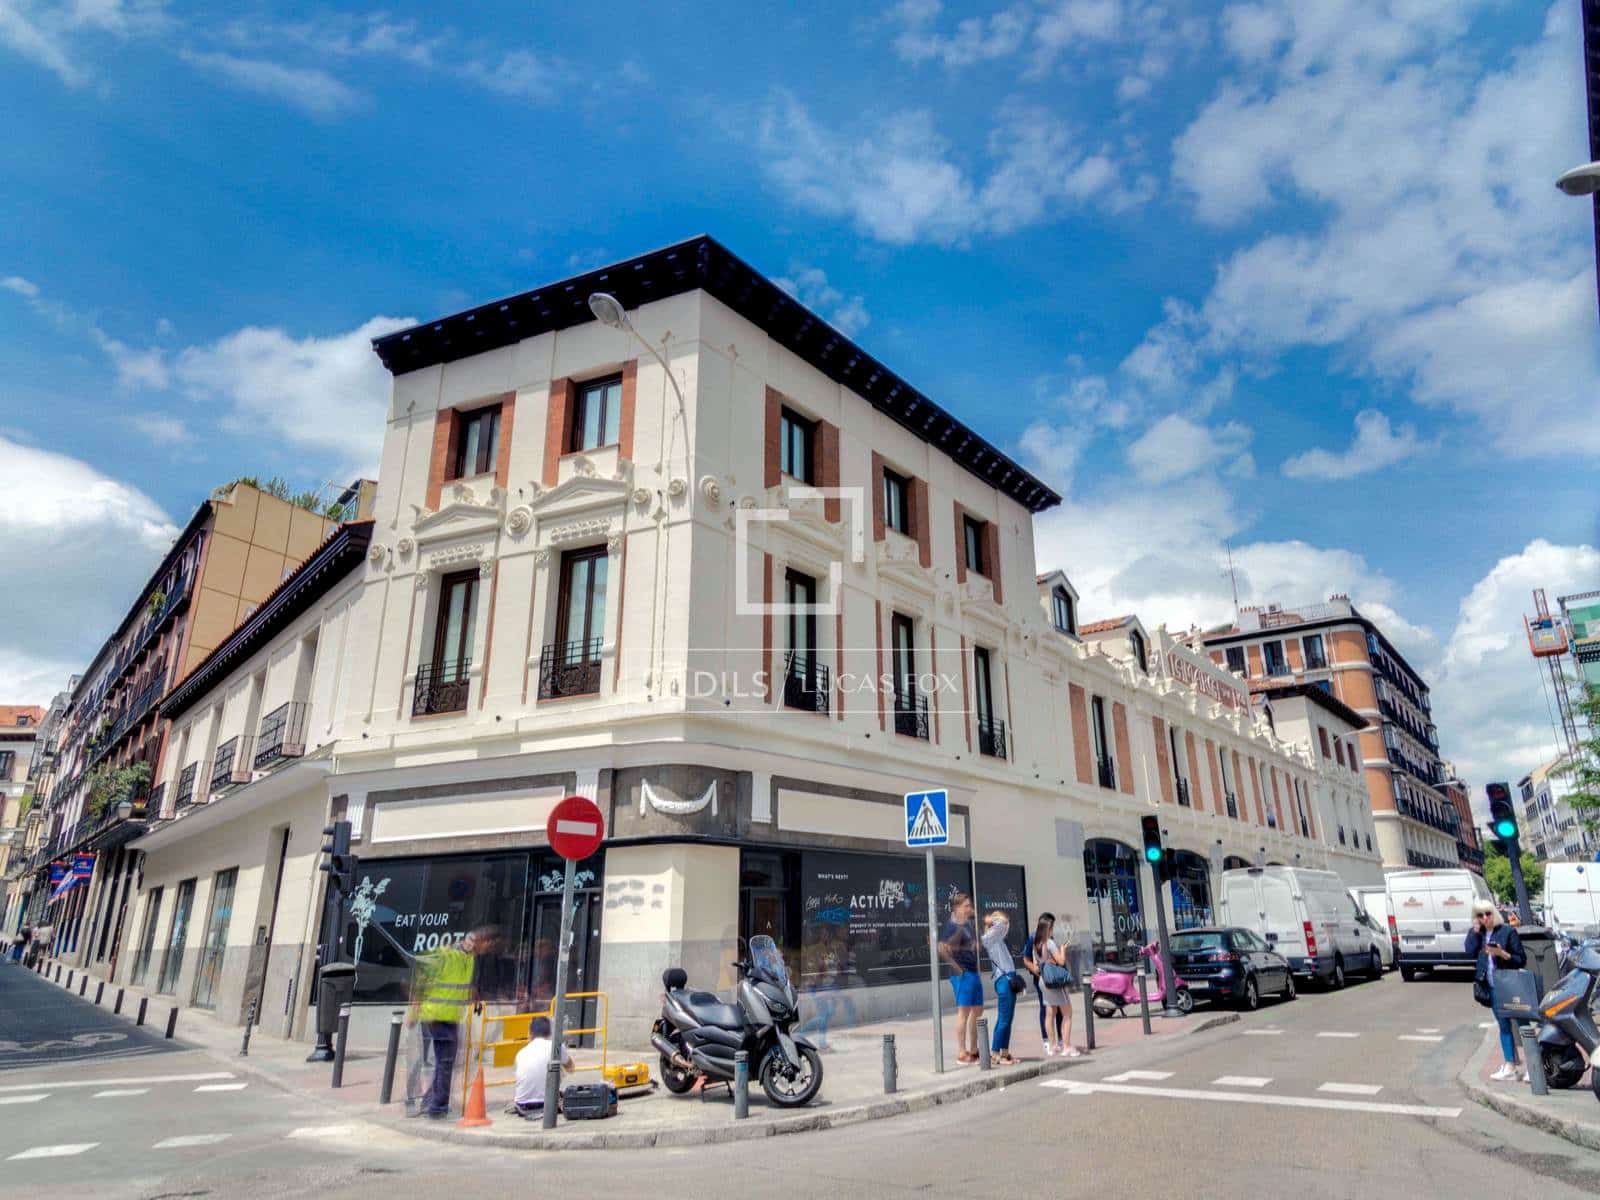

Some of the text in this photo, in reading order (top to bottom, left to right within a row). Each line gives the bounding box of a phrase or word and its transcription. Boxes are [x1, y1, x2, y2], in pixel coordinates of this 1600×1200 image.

[850, 895, 895, 909] ACTIVE
[1087, 887, 1134, 905] COMNG
[394, 913, 449, 928] EAT YOUR
[1118, 914, 1144, 933] OON
